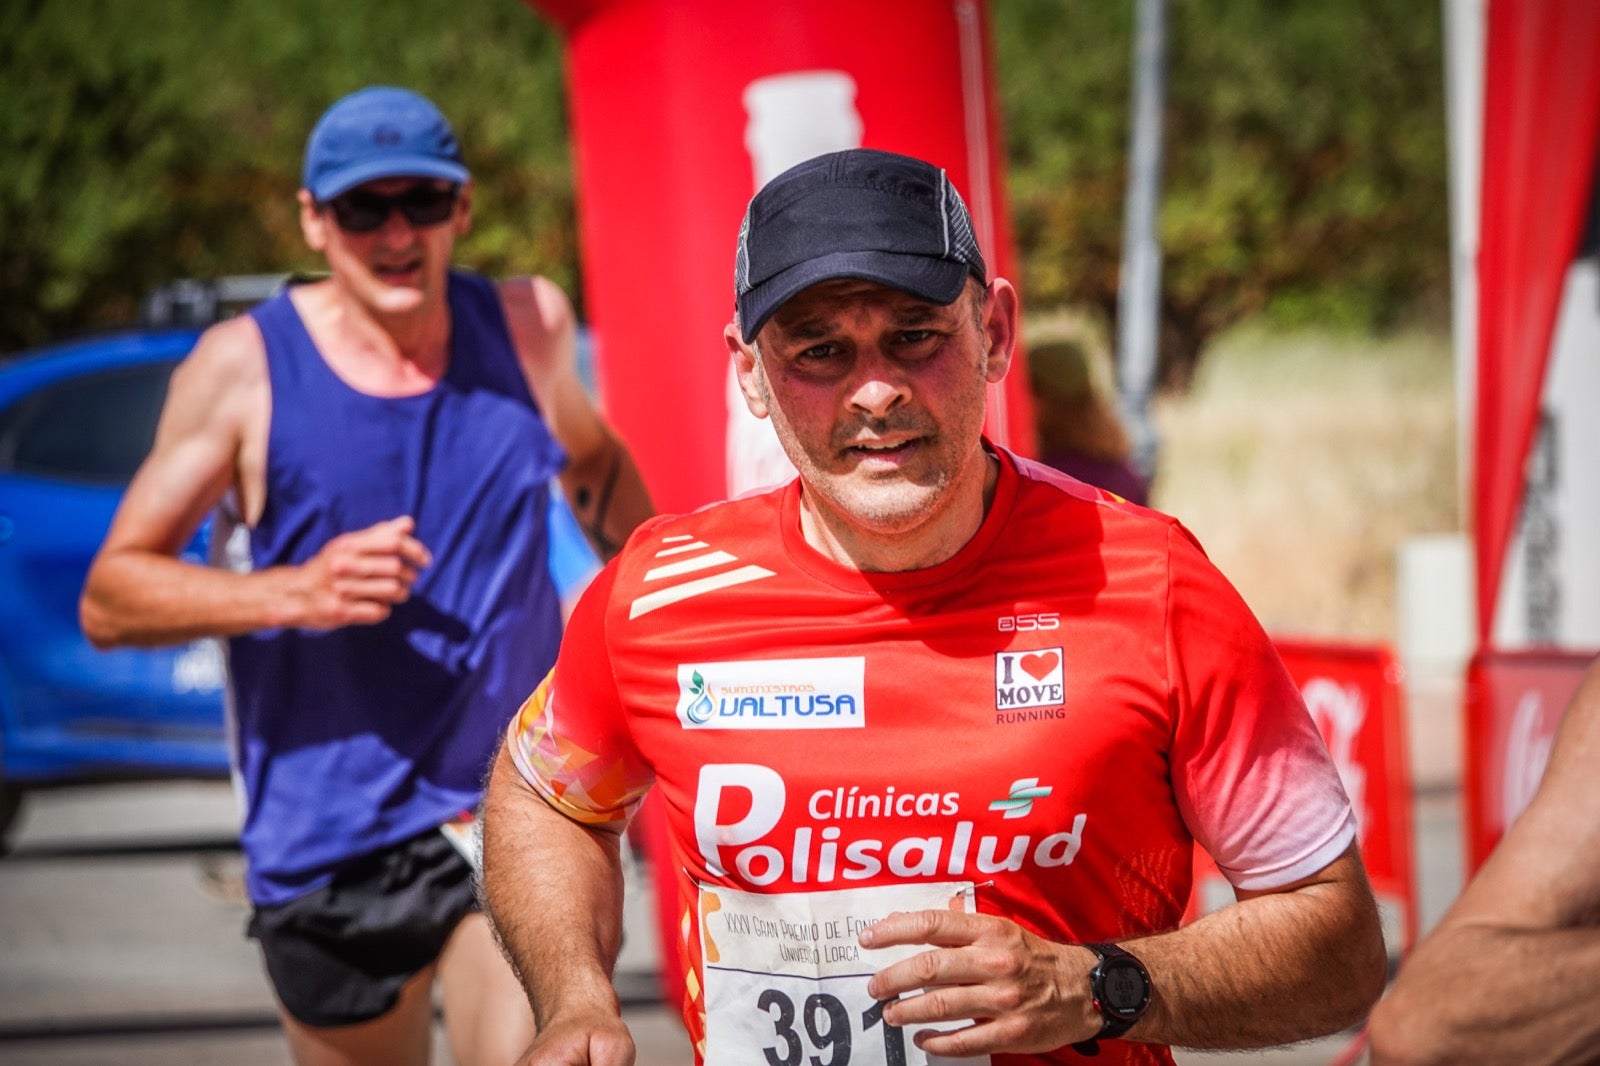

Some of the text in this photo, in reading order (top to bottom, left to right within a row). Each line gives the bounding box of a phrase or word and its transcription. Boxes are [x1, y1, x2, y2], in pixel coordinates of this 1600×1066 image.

[1003, 656, 1014, 684] I
[721, 683, 815, 695] SUMINISTROS
[998, 684, 1062, 706] MOVE
[719, 694, 856, 717] VALTUSA
[996, 708, 1066, 725] RUNNING
[808, 785, 960, 820] Clínicas
[694, 763, 1087, 886] Polisalud
[757, 988, 907, 1066] 391
